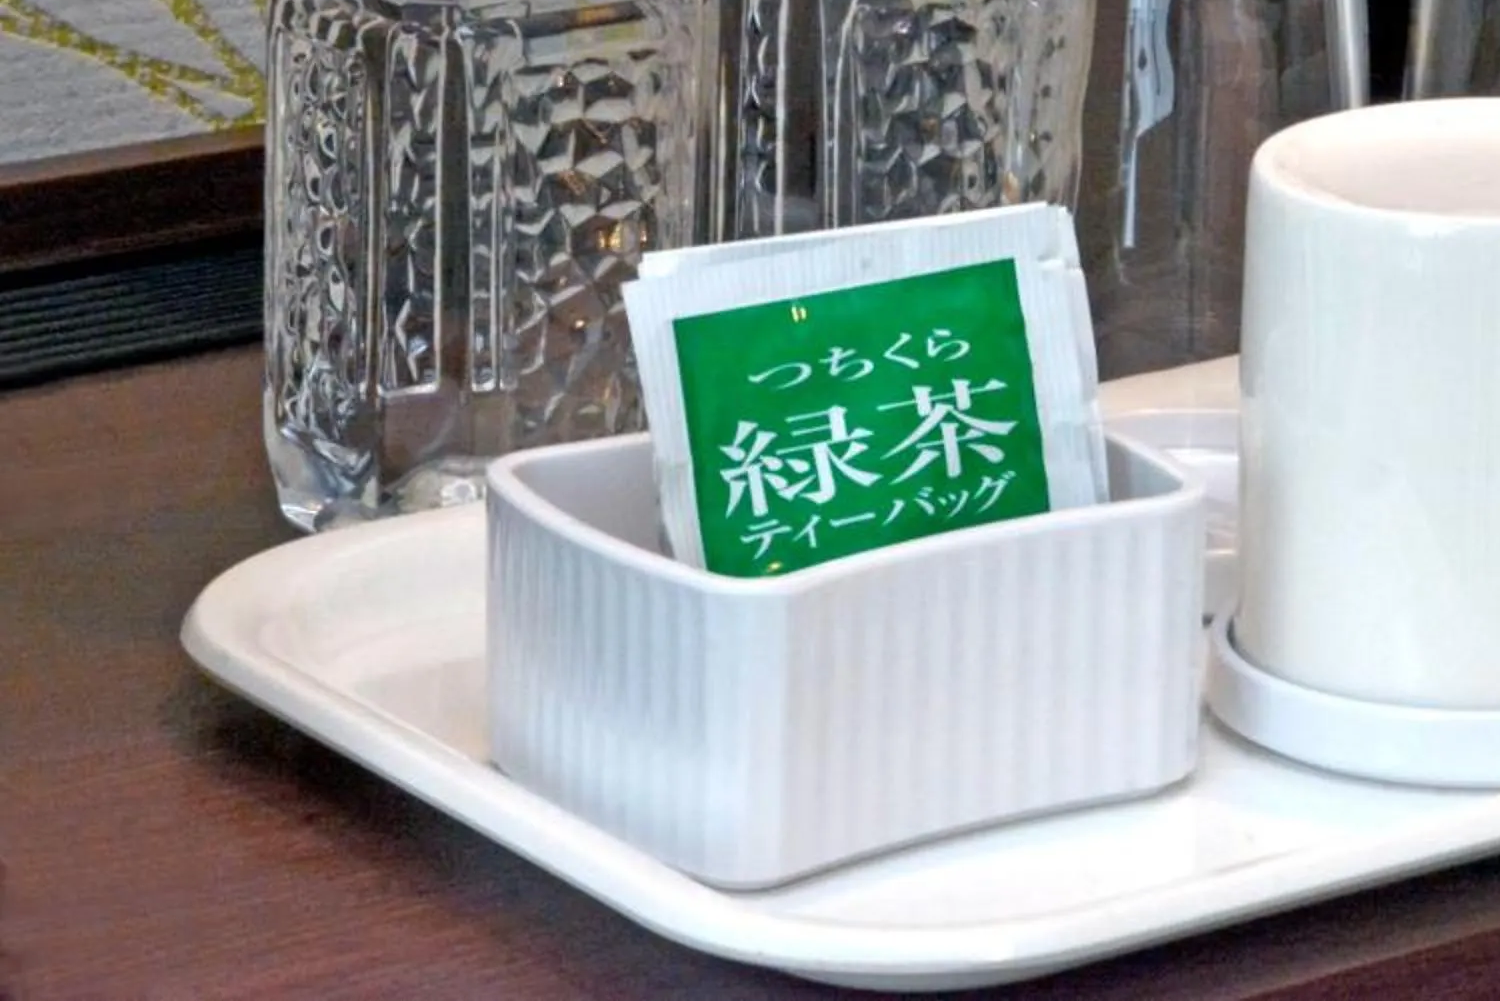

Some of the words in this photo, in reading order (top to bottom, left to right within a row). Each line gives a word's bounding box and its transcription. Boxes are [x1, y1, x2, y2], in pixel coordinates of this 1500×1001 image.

[748, 328, 971, 391] つちくら
[719, 378, 1019, 518] 緑茶
[740, 470, 1017, 560] ティーバッグ
